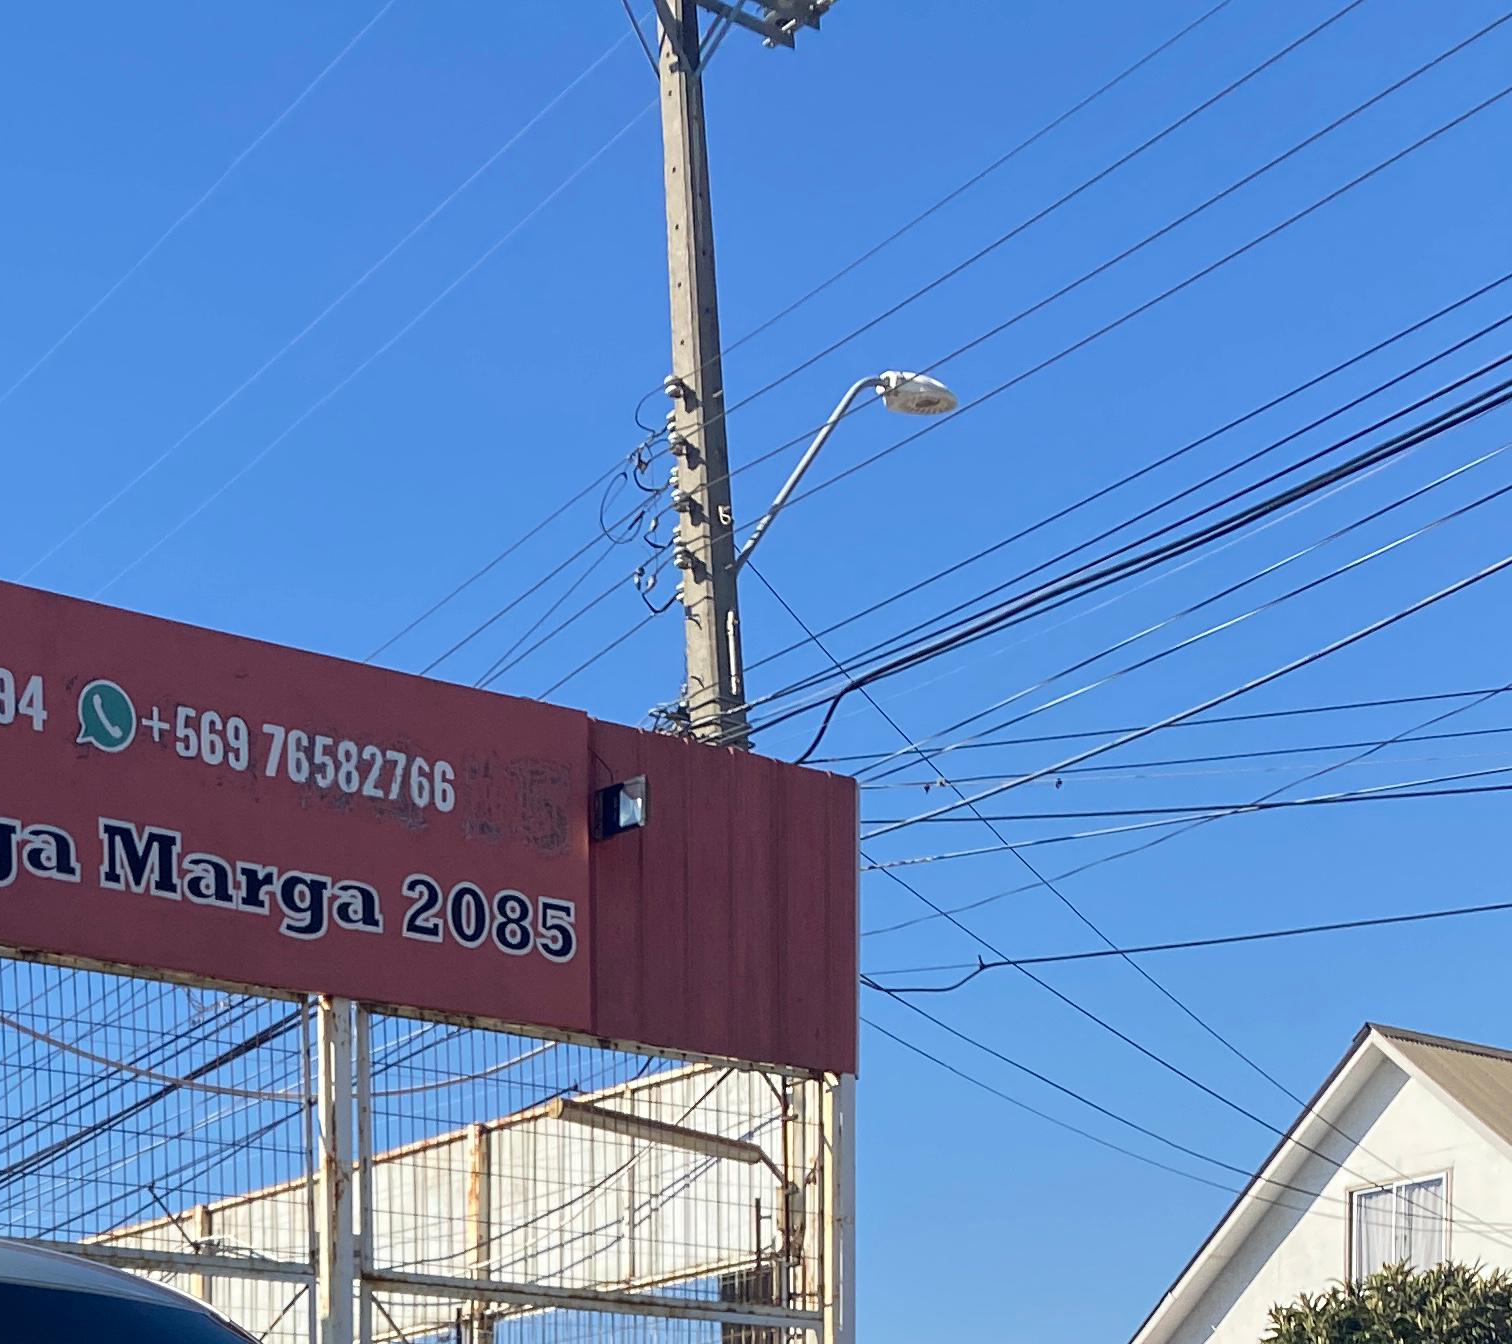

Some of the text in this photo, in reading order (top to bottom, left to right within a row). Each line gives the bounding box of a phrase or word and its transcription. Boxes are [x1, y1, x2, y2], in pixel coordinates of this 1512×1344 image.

[141, 705, 250, 771] +569
[262, 722, 456, 813] 76582766
[98, 816, 385, 941] Marga
[402, 873, 577, 964] 2085
